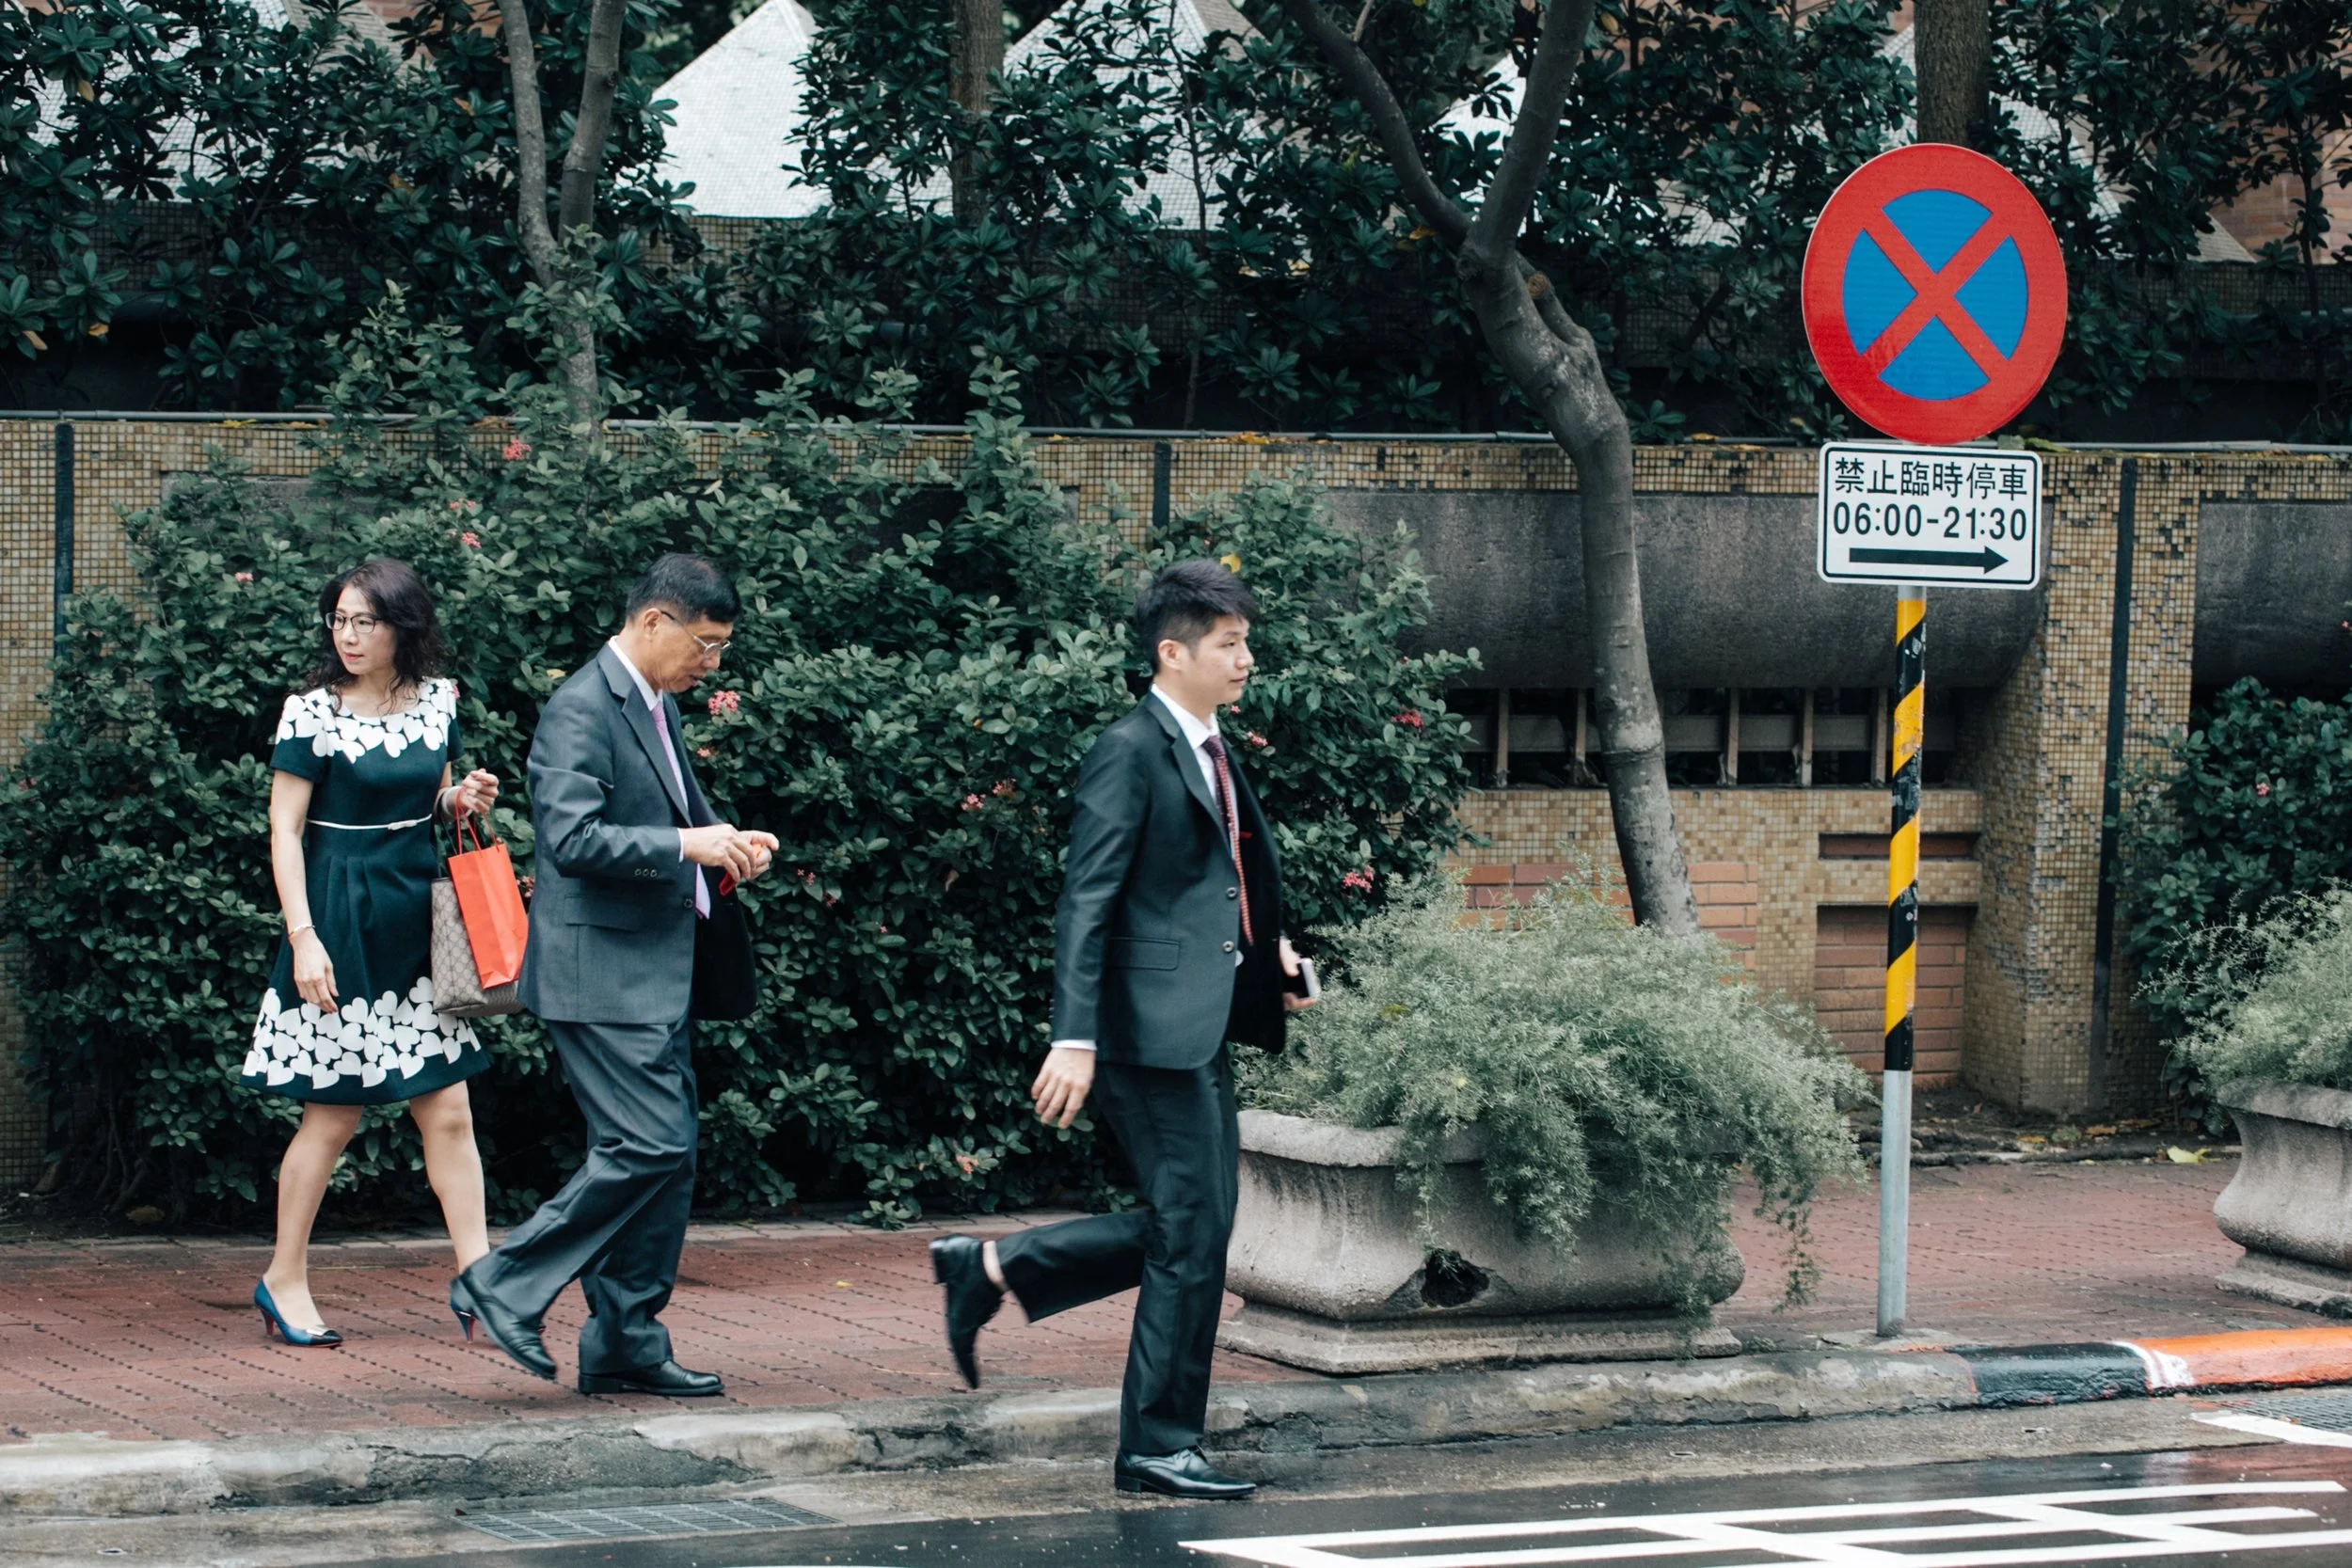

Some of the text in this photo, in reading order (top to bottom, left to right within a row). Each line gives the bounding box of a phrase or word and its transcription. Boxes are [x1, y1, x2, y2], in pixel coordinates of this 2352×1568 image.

[1835, 457, 2027, 500] 禁止臨時停車
[1834, 501, 2026, 541] 06:00-21:30
